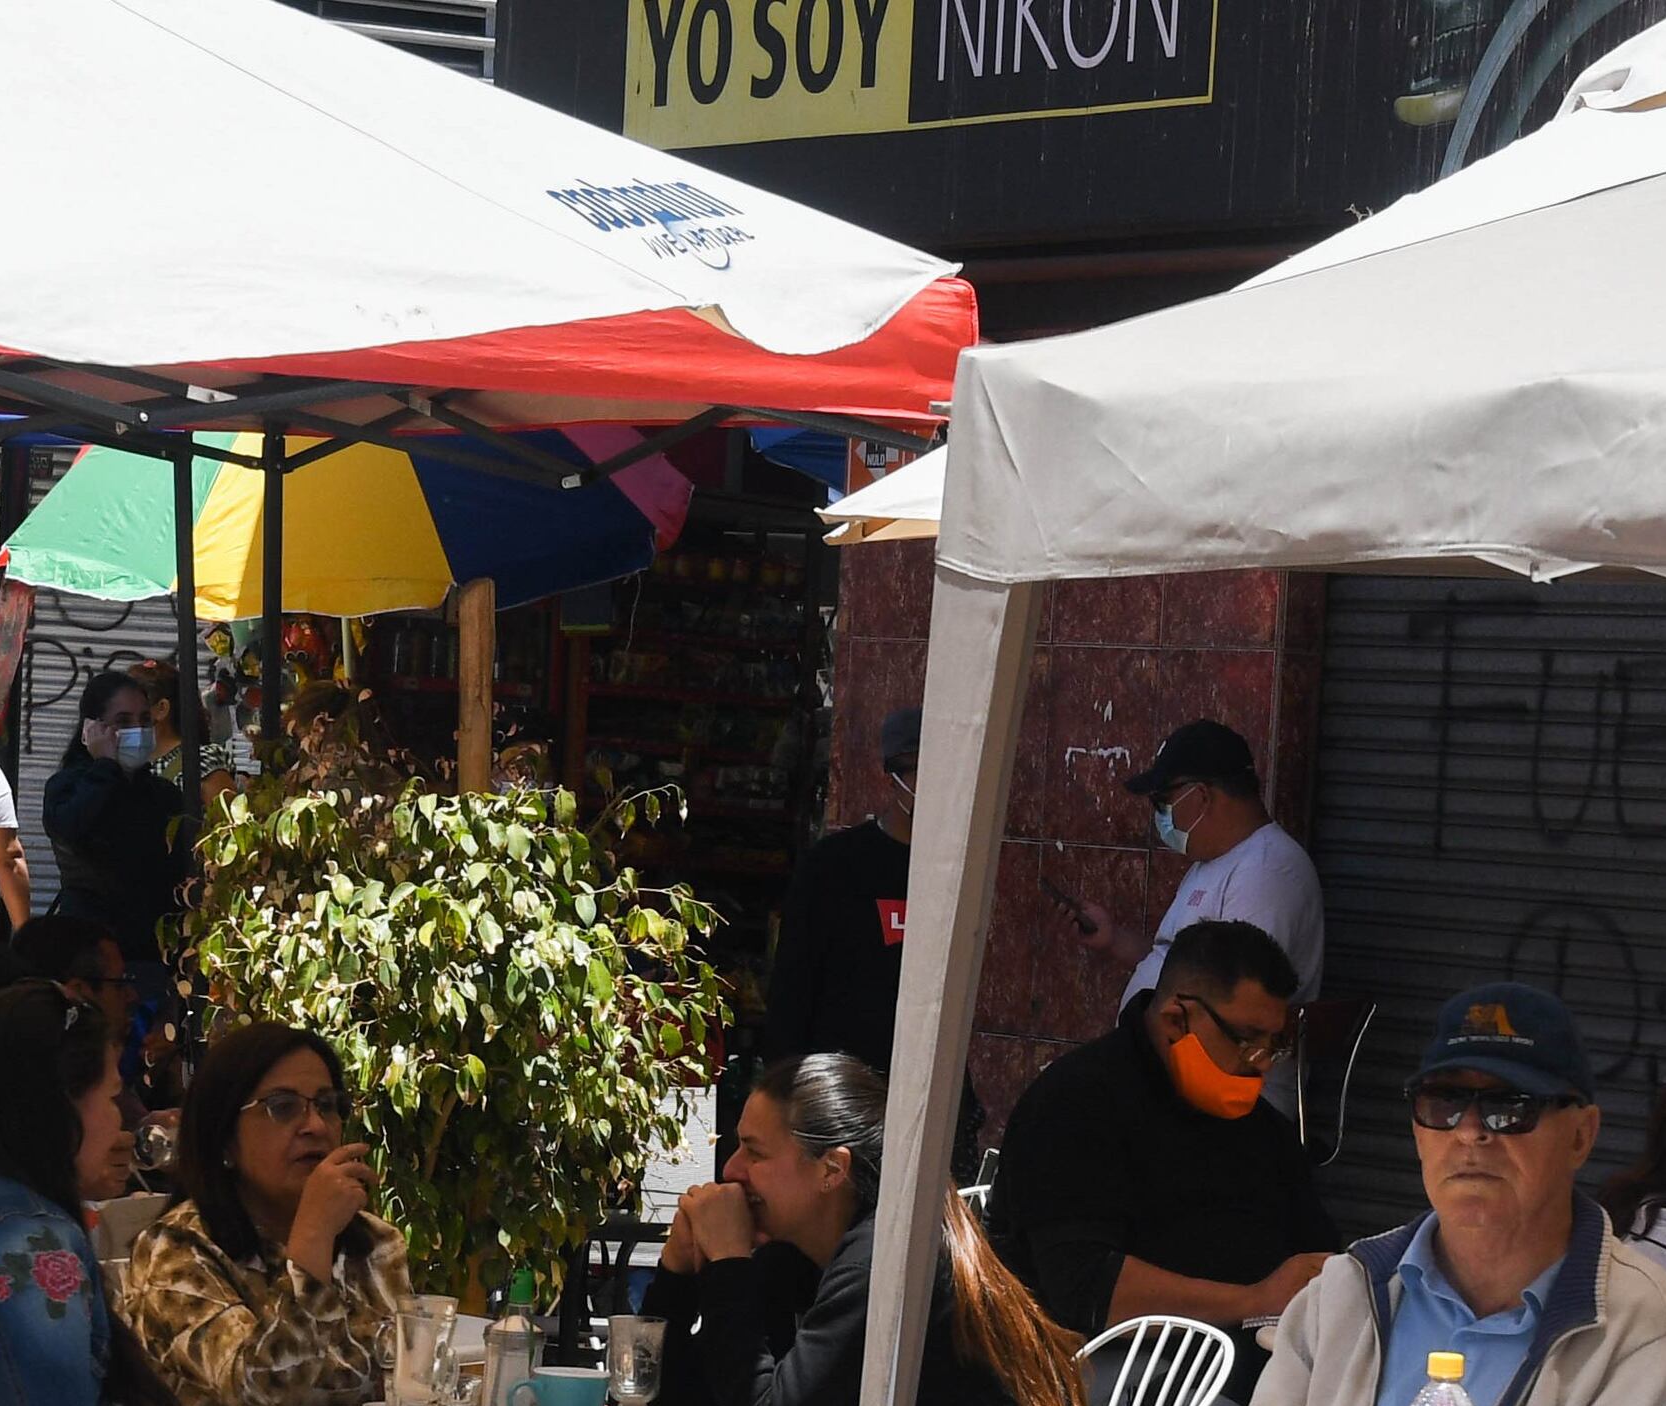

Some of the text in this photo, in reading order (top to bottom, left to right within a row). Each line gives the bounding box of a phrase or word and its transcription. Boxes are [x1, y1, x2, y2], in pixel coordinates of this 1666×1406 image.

[644, 0, 1179, 107] YO SOY NIKON
